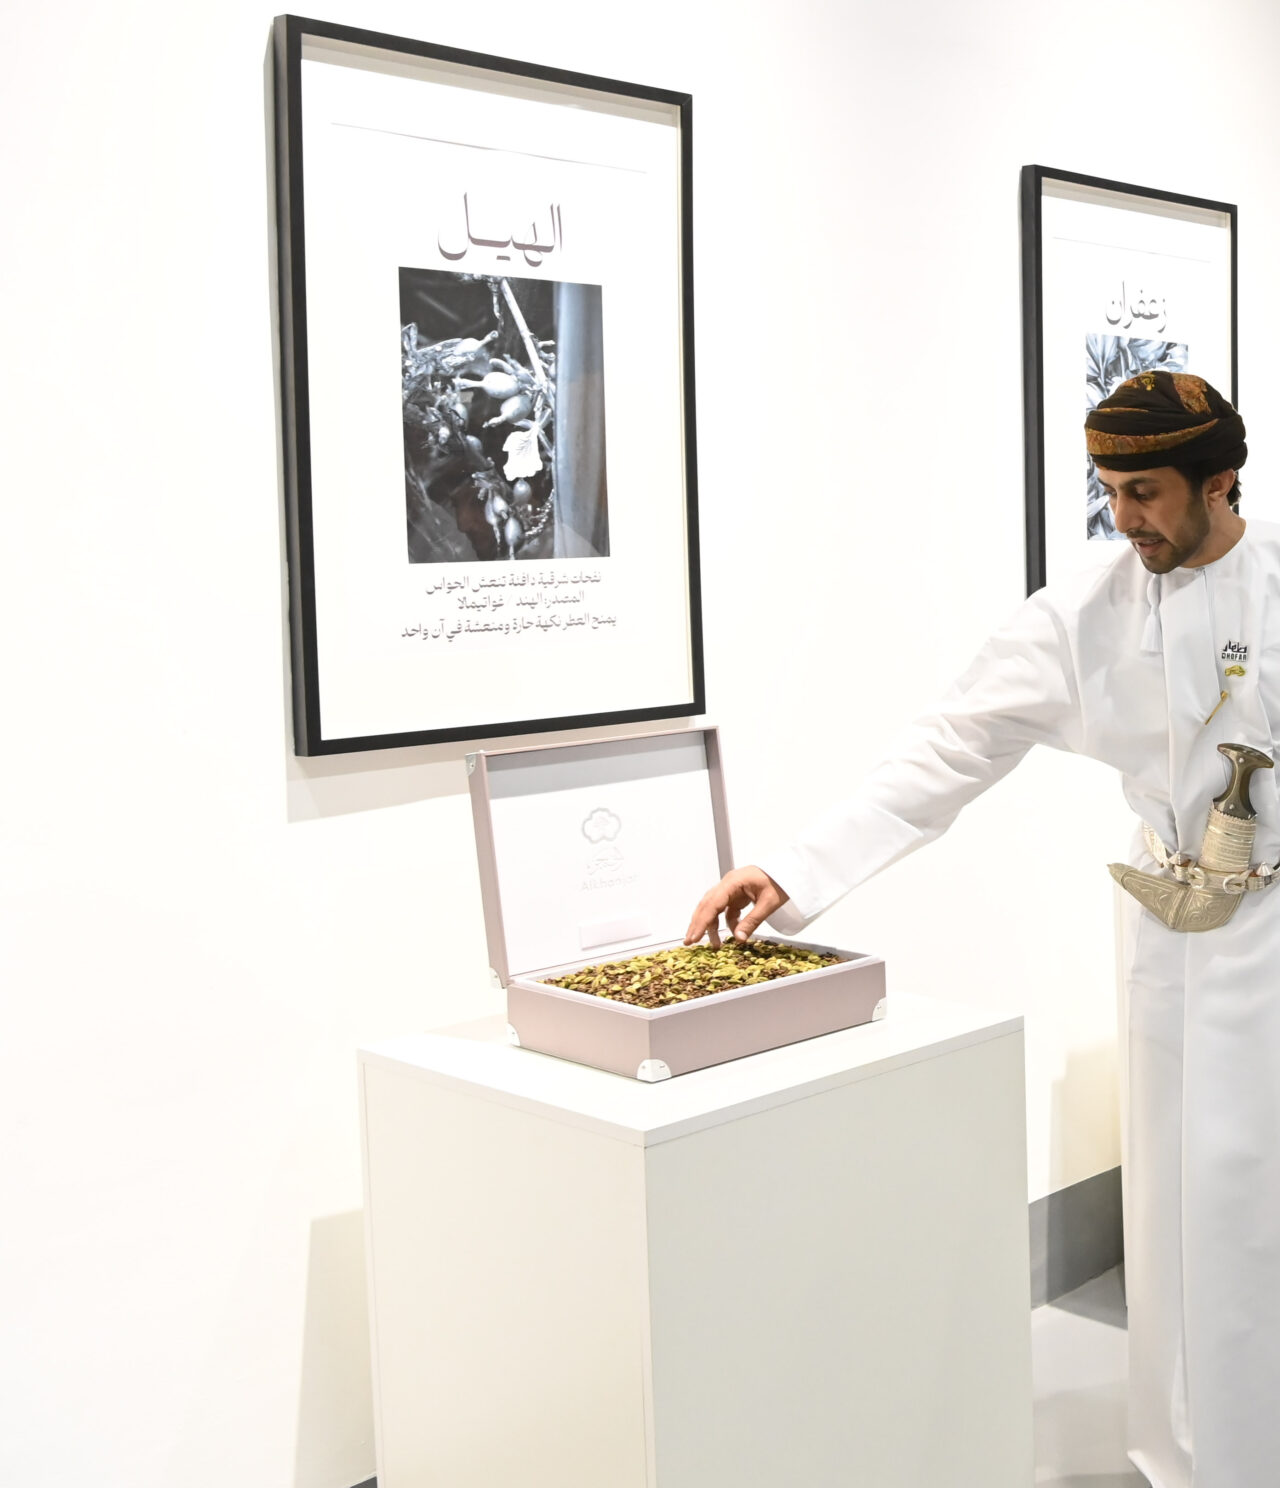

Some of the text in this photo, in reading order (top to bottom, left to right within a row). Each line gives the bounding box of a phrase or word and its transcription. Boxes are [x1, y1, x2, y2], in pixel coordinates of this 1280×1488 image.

[437, 191, 562, 268] الهيل
[1105, 280, 1167, 333] زعفران
[425, 571, 602, 595] نفحات شرقية دافئة تنعش الحواس
[457, 593, 505, 612] غواتيمالا
[515, 591, 543, 610] الهند
[401, 611, 617, 642] يمنح العطر نكهة حارة ومنعشة في آن واحد
